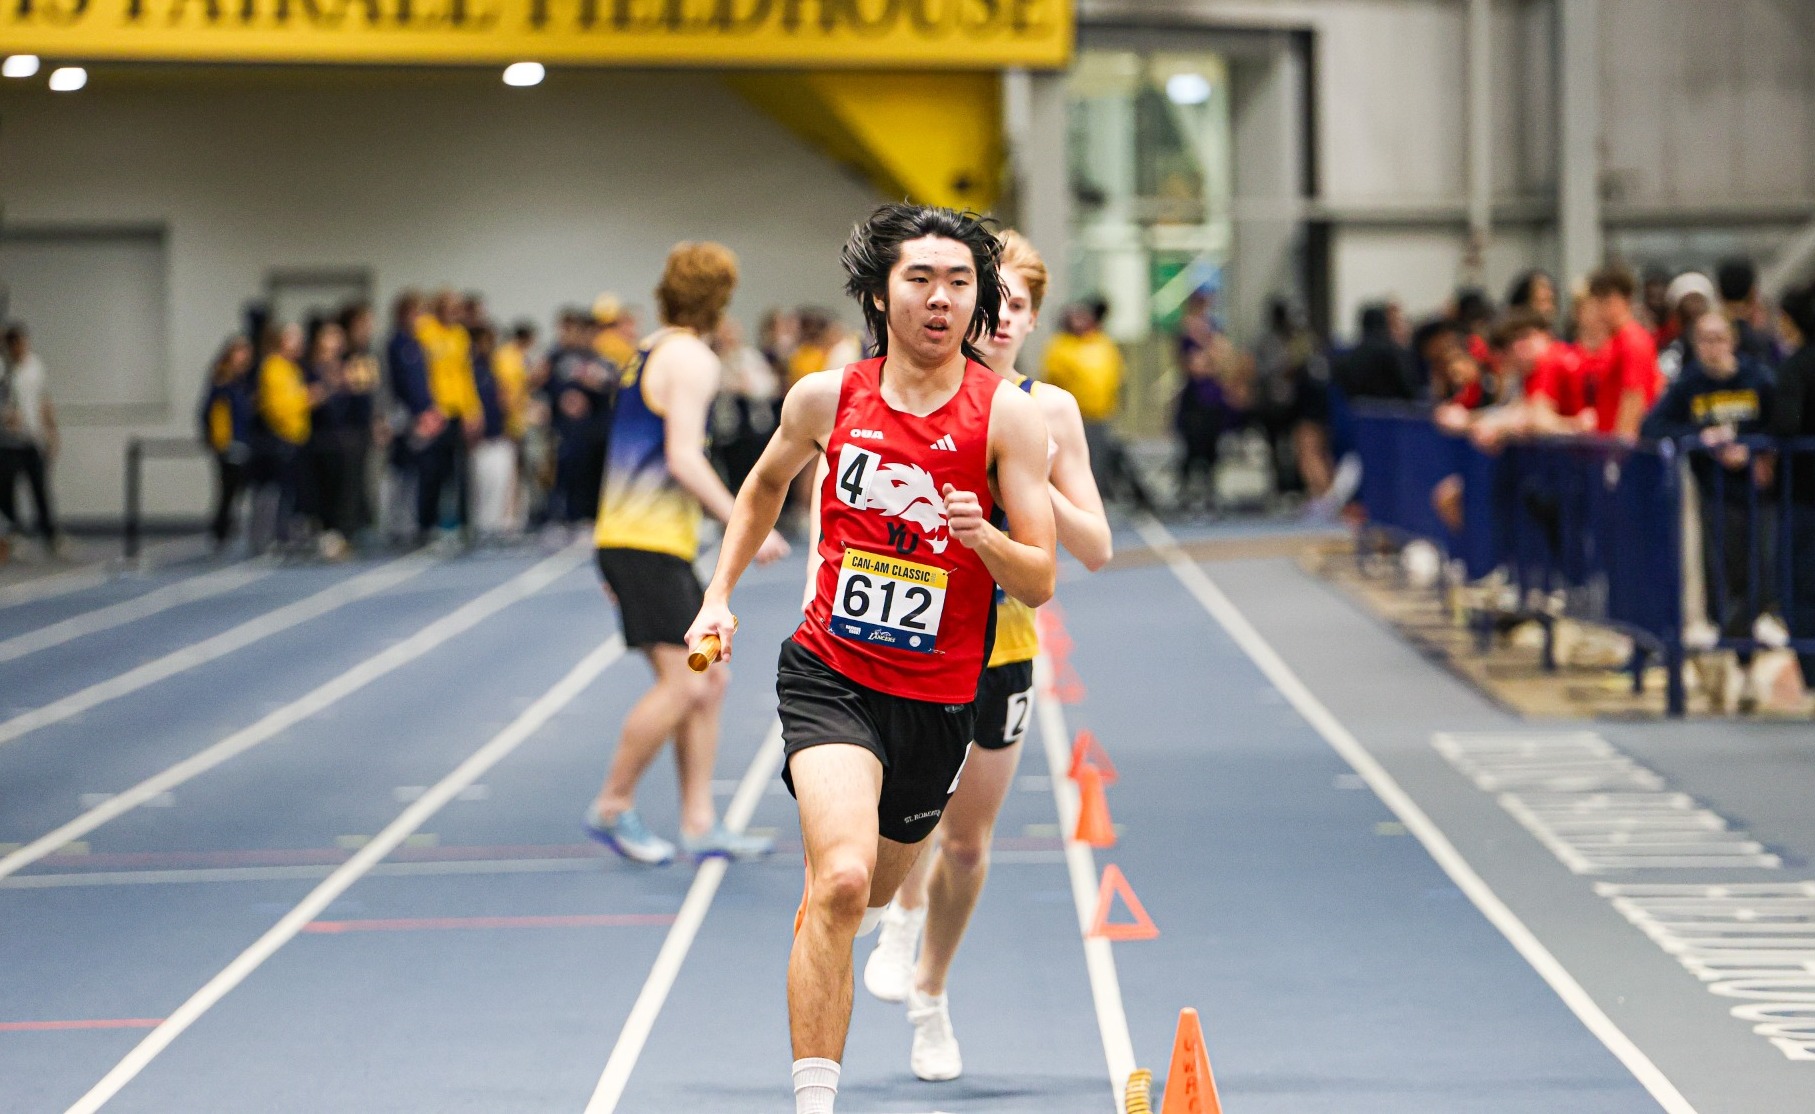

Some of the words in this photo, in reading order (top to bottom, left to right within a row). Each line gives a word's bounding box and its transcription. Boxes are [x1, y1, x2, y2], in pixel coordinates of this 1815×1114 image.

[849, 428, 884, 440] OUA
[840, 452, 869, 505] 4
[886, 521, 919, 555] YU
[851, 556, 890, 573] CAN-AM
[891, 564, 931, 583] CLASSIC
[842, 574, 932, 631] 612
[1012, 695, 1029, 736] 2
